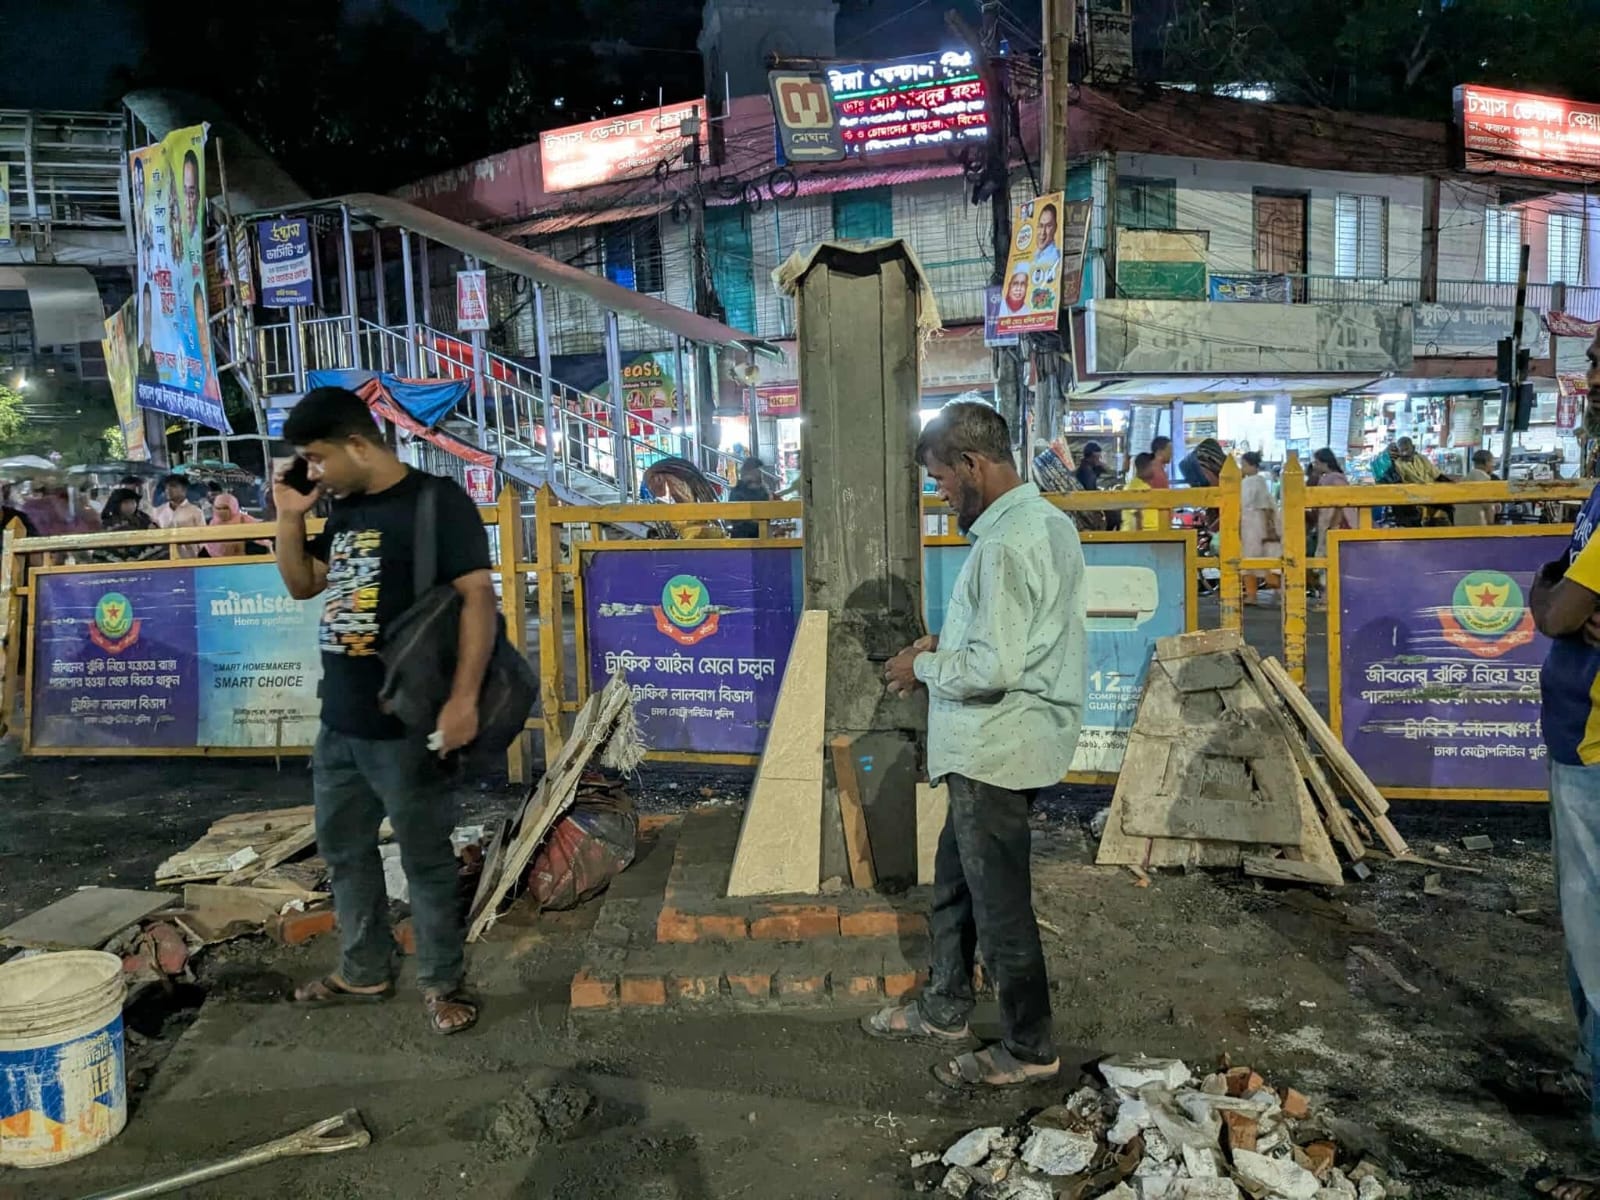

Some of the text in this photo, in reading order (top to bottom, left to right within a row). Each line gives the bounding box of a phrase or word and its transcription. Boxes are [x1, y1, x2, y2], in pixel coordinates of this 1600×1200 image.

[1466, 90, 1507, 118] টমাস
[590, 117, 645, 141] ডেন্টাল
[1416, 303, 1460, 327] স্টুডিও
[622, 361, 660, 378] east
[234, 617, 260, 627] Home
[107, 657, 126, 671] নিয়ে
[242, 662, 302, 671] HOMEMAKER'S
[605, 650, 775, 680] ট্রাফিক আইন মেনে চলুন
[214, 676, 304, 689] SMART CHOICE
[1090, 671, 1120, 692] 12
[1365, 664, 1428, 686] জীবনের
[1433, 663, 1468, 684] ঝুঁকি
[1472, 663, 1508, 683] নিয়ে
[101, 698, 137, 710] লালবাগ
[139, 695, 166, 709] বিভাগ
[671, 689, 716, 703] লালবাগ
[719, 685, 754, 703] বিভাগ
[1434, 746, 1458, 757] ঢাকা
[1461, 744, 1525, 759] মেট্রোপলিটন
